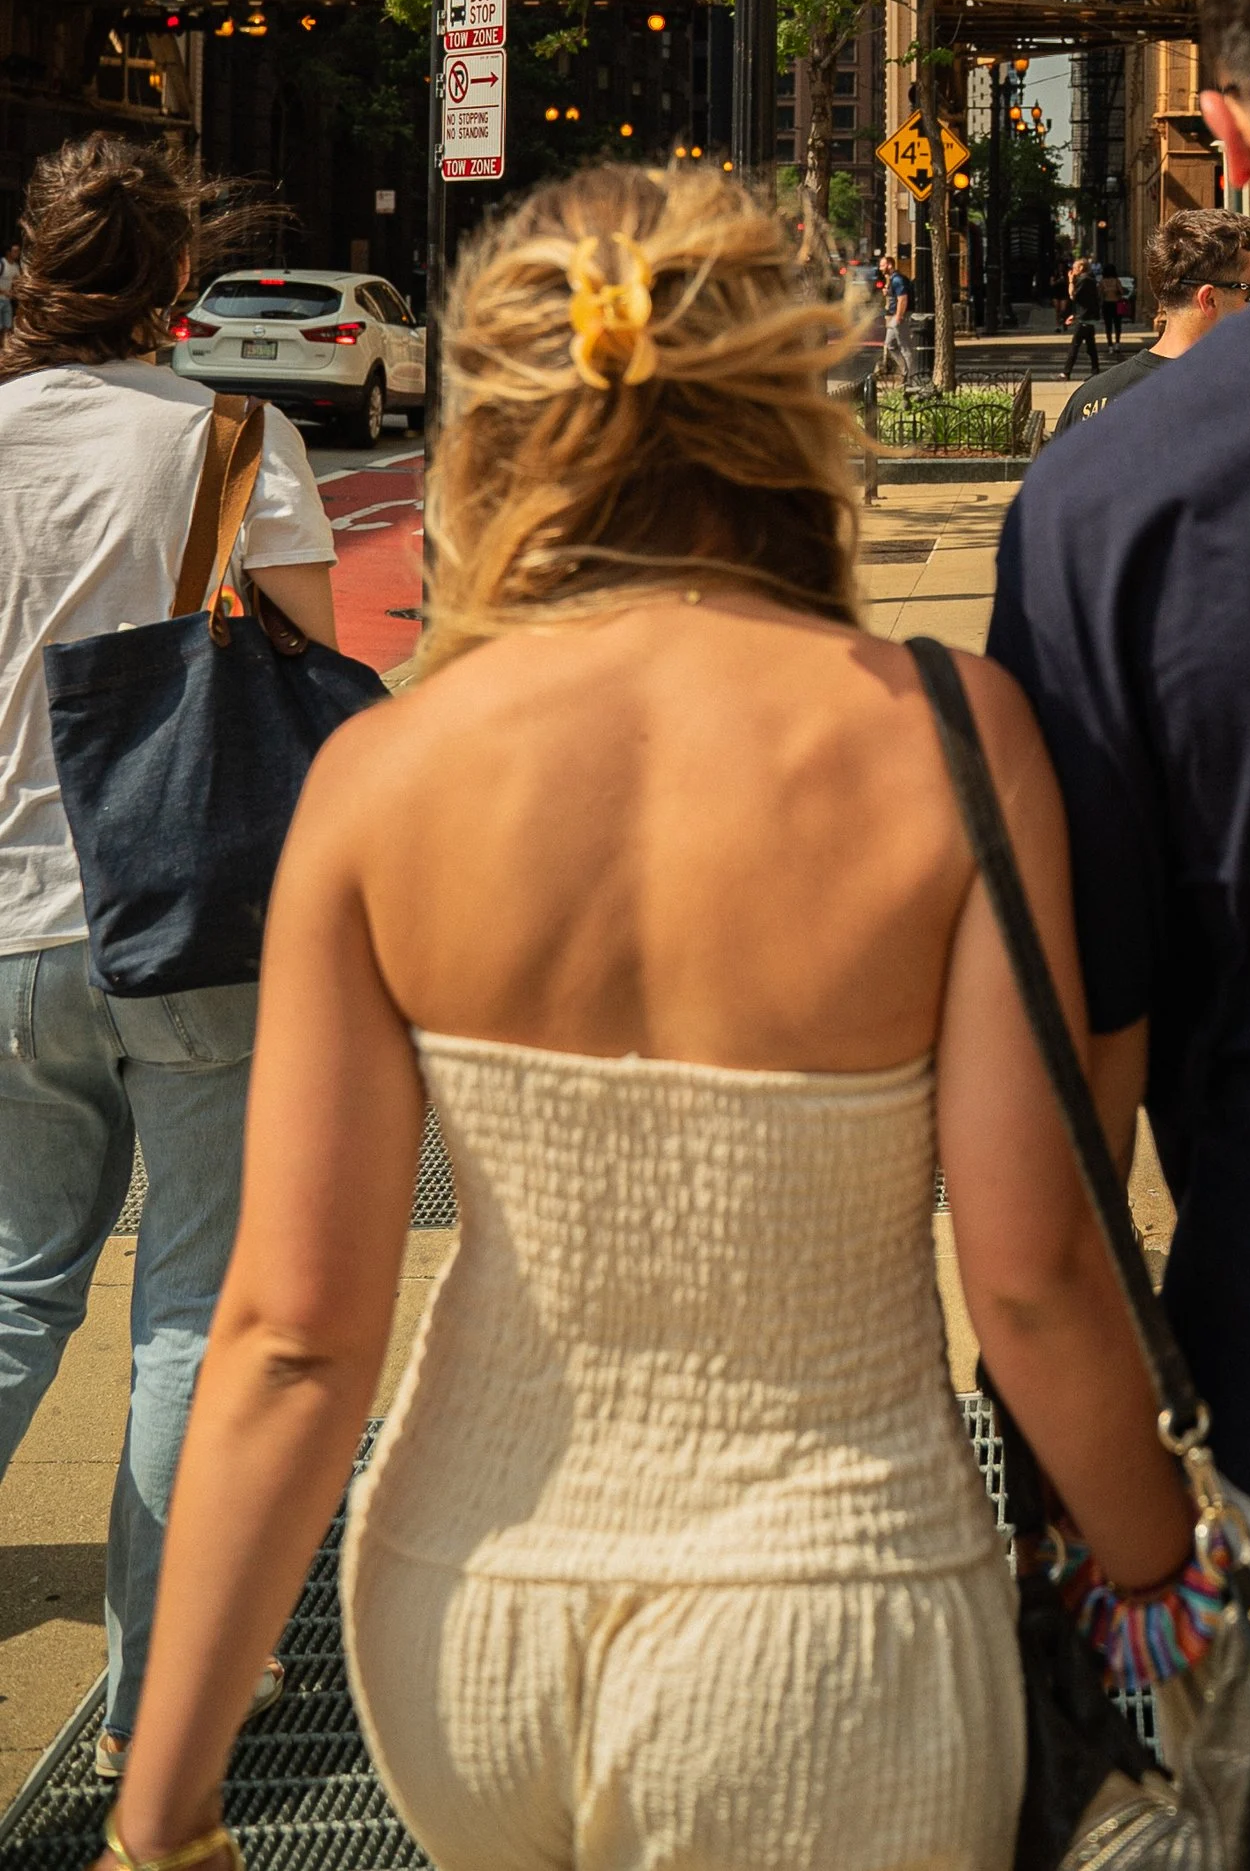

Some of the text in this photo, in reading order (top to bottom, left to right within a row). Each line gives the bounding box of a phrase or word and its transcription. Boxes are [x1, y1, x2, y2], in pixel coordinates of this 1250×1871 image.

[470, 3, 496, 25] STOP
[448, 28, 499, 48] TOW ZONE
[446, 111, 489, 126] NO STOPPING
[446, 125, 489, 140] NO STANDING
[445, 158, 497, 176] TOW ZONE
